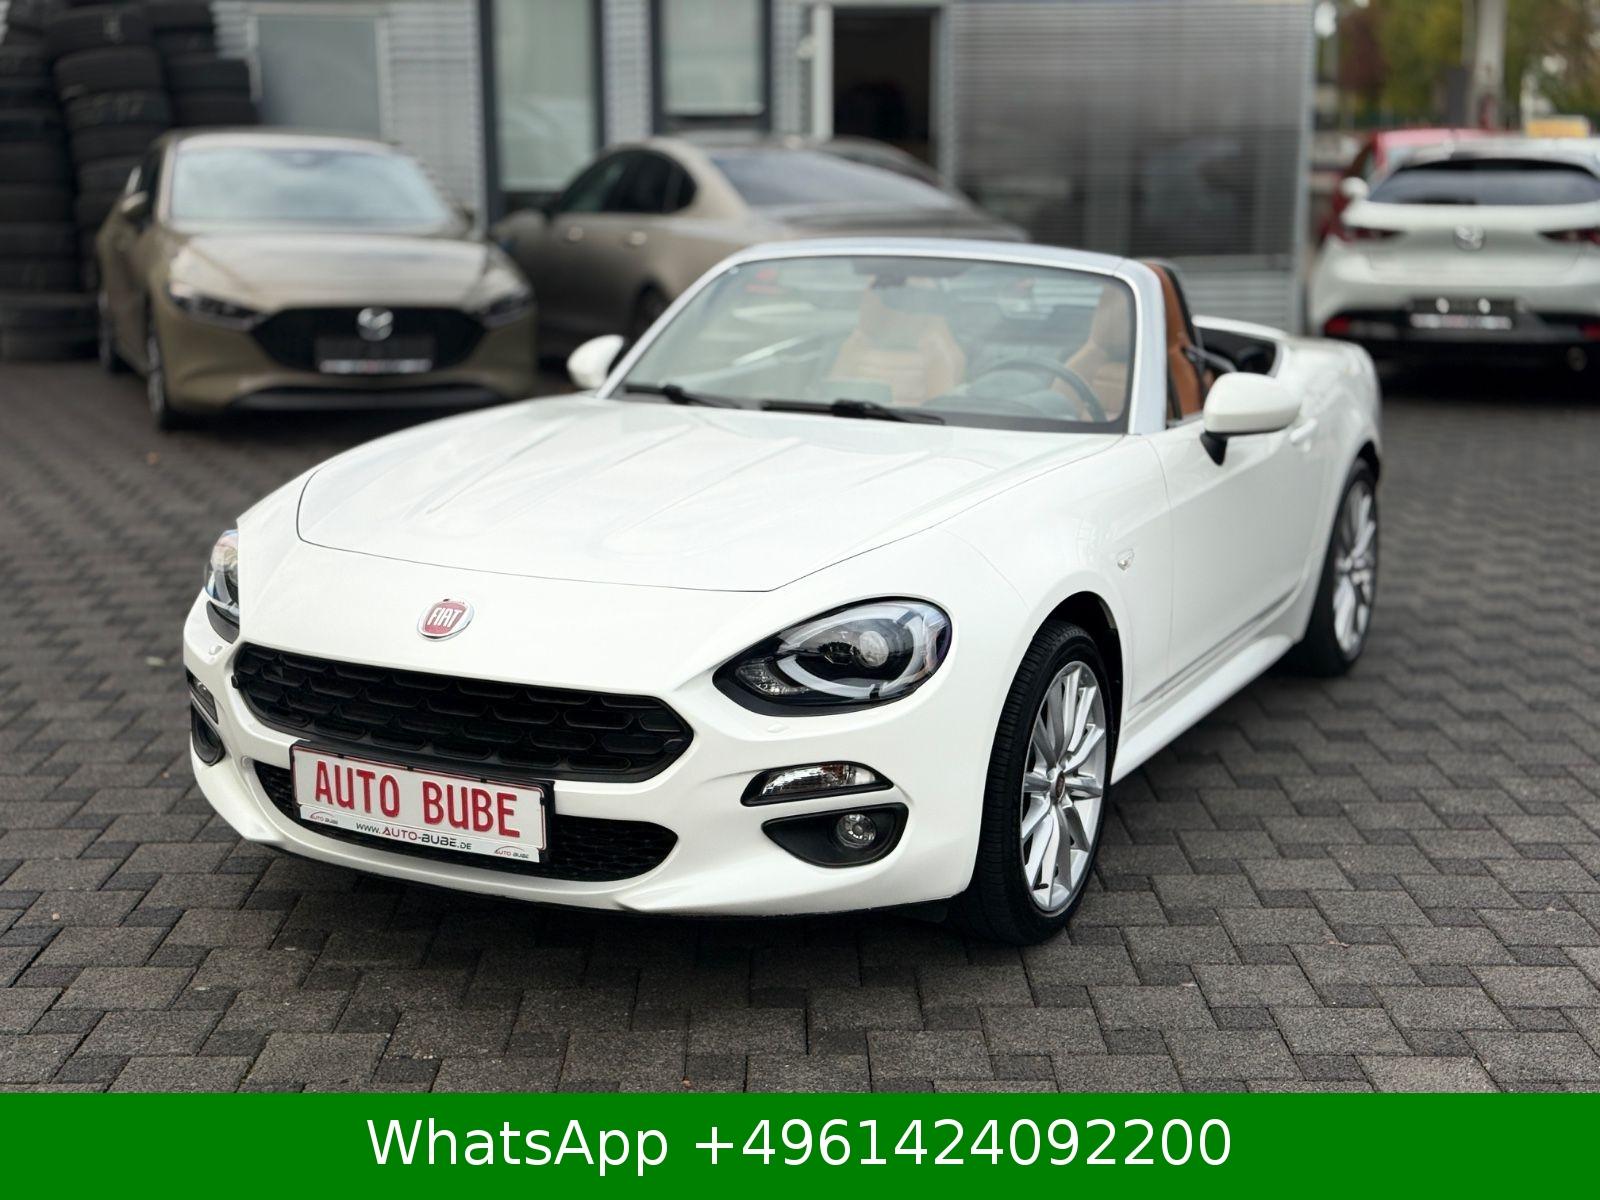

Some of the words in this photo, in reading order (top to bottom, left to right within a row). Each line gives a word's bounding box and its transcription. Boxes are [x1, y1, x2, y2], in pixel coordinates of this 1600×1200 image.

[427, 607, 463, 628] FIAT
[315, 760, 400, 818] AUTO
[422, 780, 521, 838] BUBE
